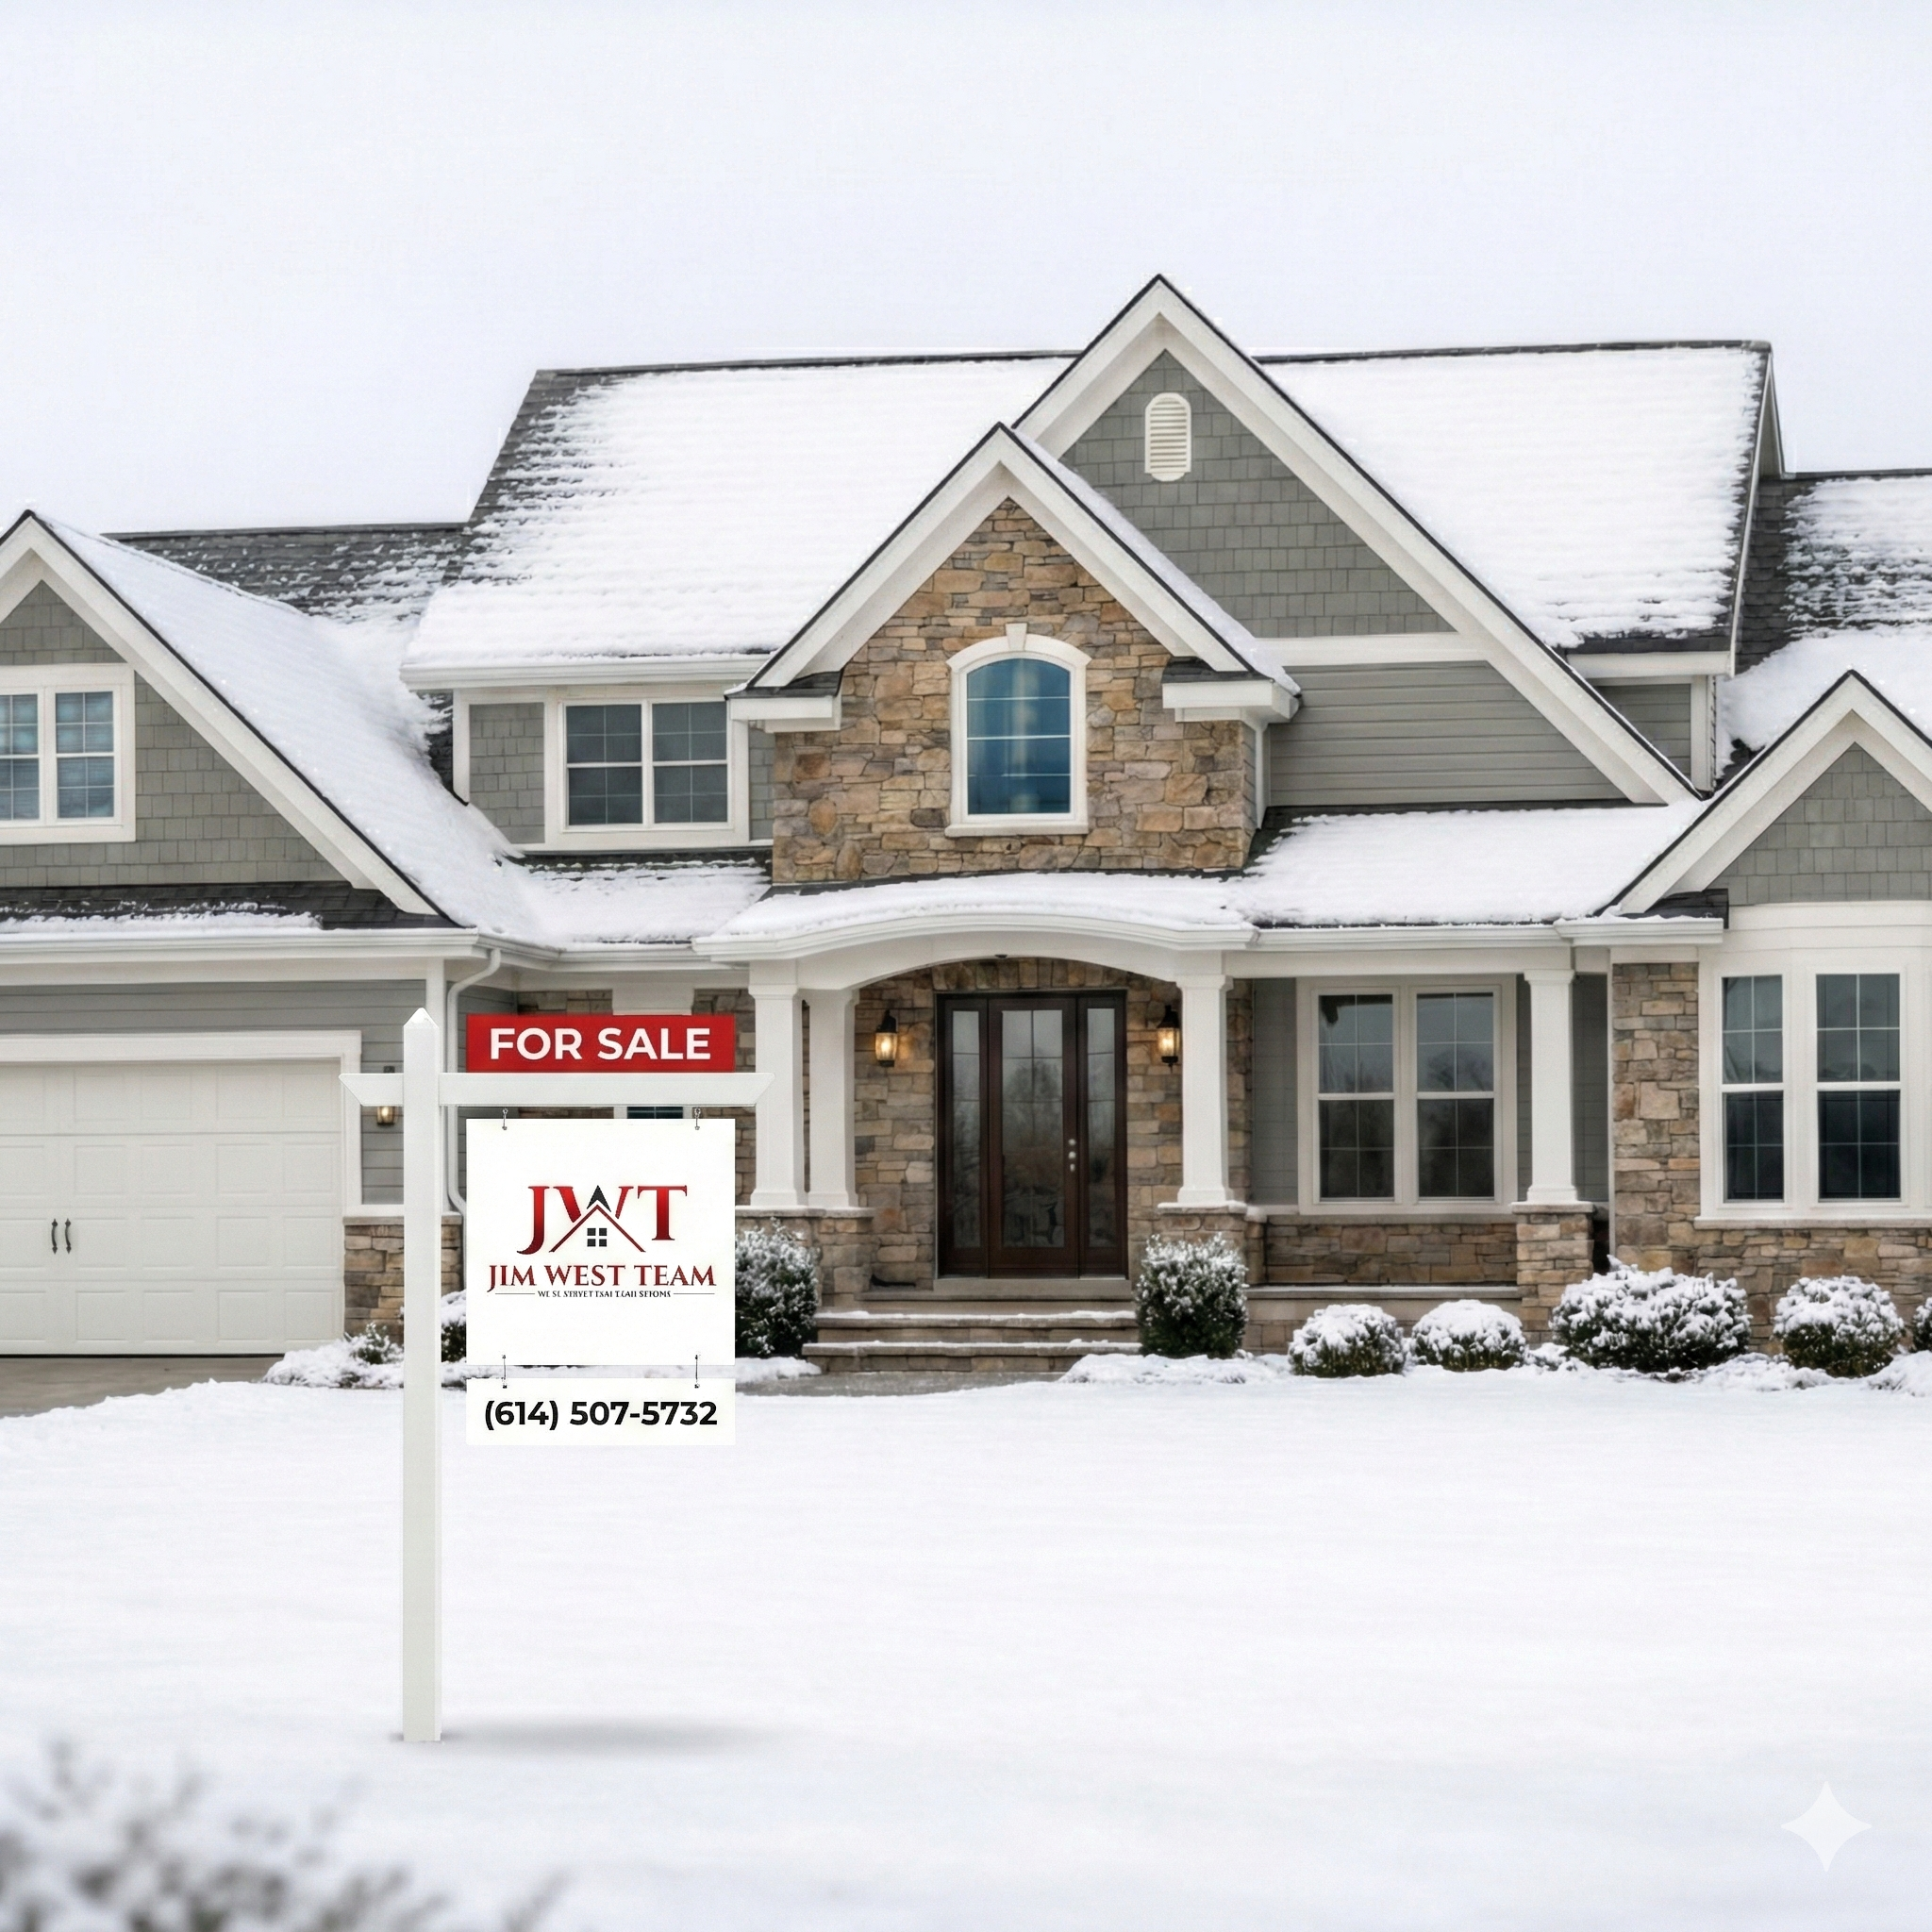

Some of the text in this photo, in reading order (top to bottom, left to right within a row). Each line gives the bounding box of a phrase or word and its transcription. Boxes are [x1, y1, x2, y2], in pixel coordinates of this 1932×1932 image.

[491, 1027, 711, 1060] FOR SALE
[517, 1185, 687, 1255] JWT
[487, 1264, 717, 1292] JIM WEST TEAM
[484, 1400, 718, 1431] (614) 507-5732
